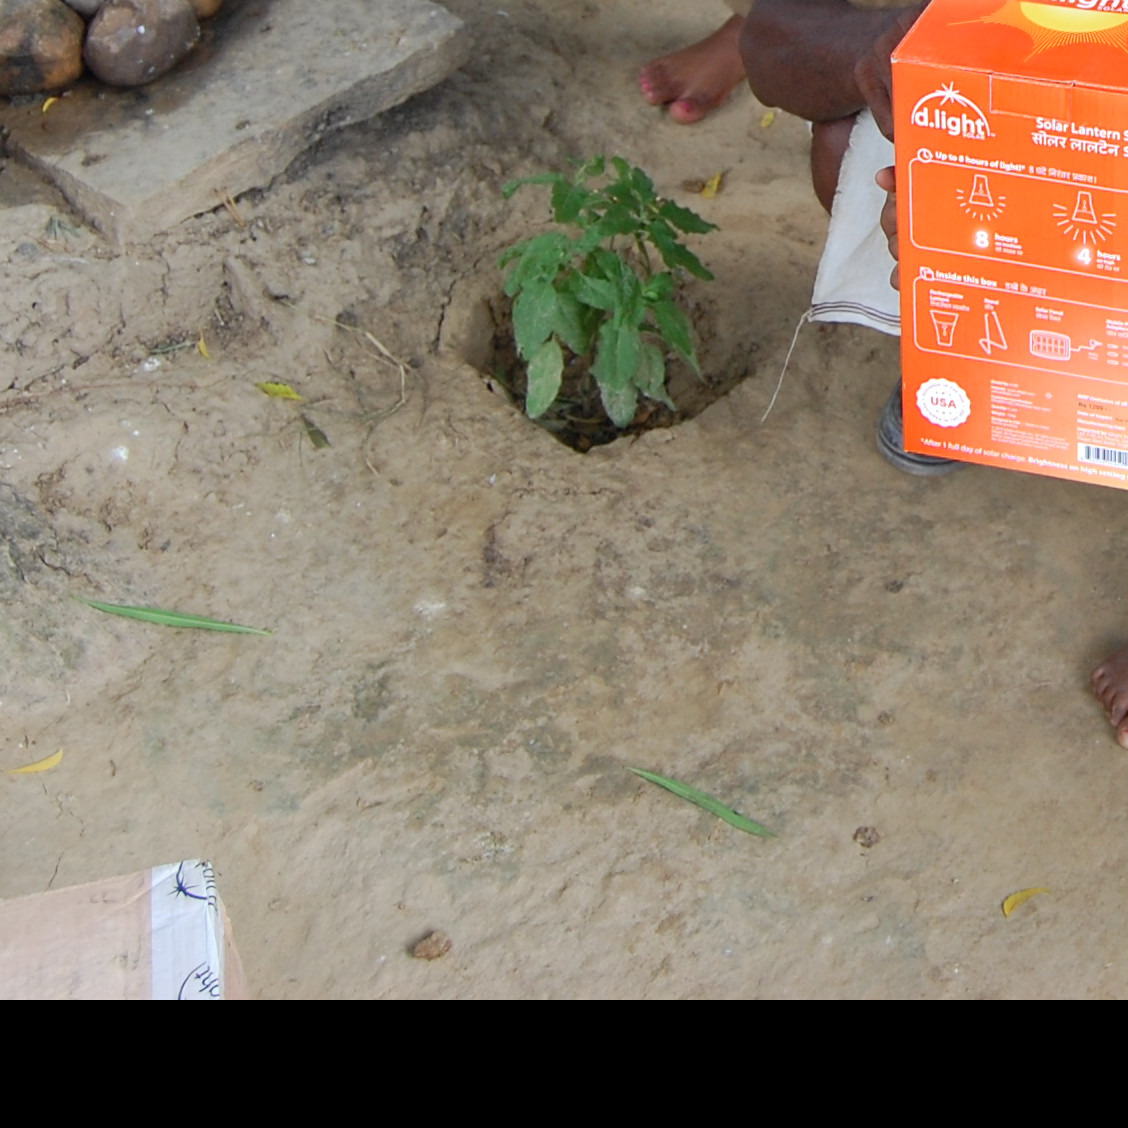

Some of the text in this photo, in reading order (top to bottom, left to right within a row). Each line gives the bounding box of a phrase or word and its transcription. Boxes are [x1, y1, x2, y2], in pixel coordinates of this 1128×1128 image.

[914, 107, 985, 136] d.light
[1036, 117, 1068, 132] Solar
[1071, 122, 1120, 140] Lantern
[1031, 130, 1067, 149] सोलर
[1070, 137, 1120, 157] लालटेन
[935, 151, 947, 161] Up
[948, 153, 957, 162] to
[965, 155, 989, 167] hours
[989, 160, 999, 168] of
[975, 230, 989, 248] 8
[1077, 248, 1091, 265] 4
[963, 274, 979, 284] this
[980, 277, 998, 287] box
[930, 396, 957, 409] USA
